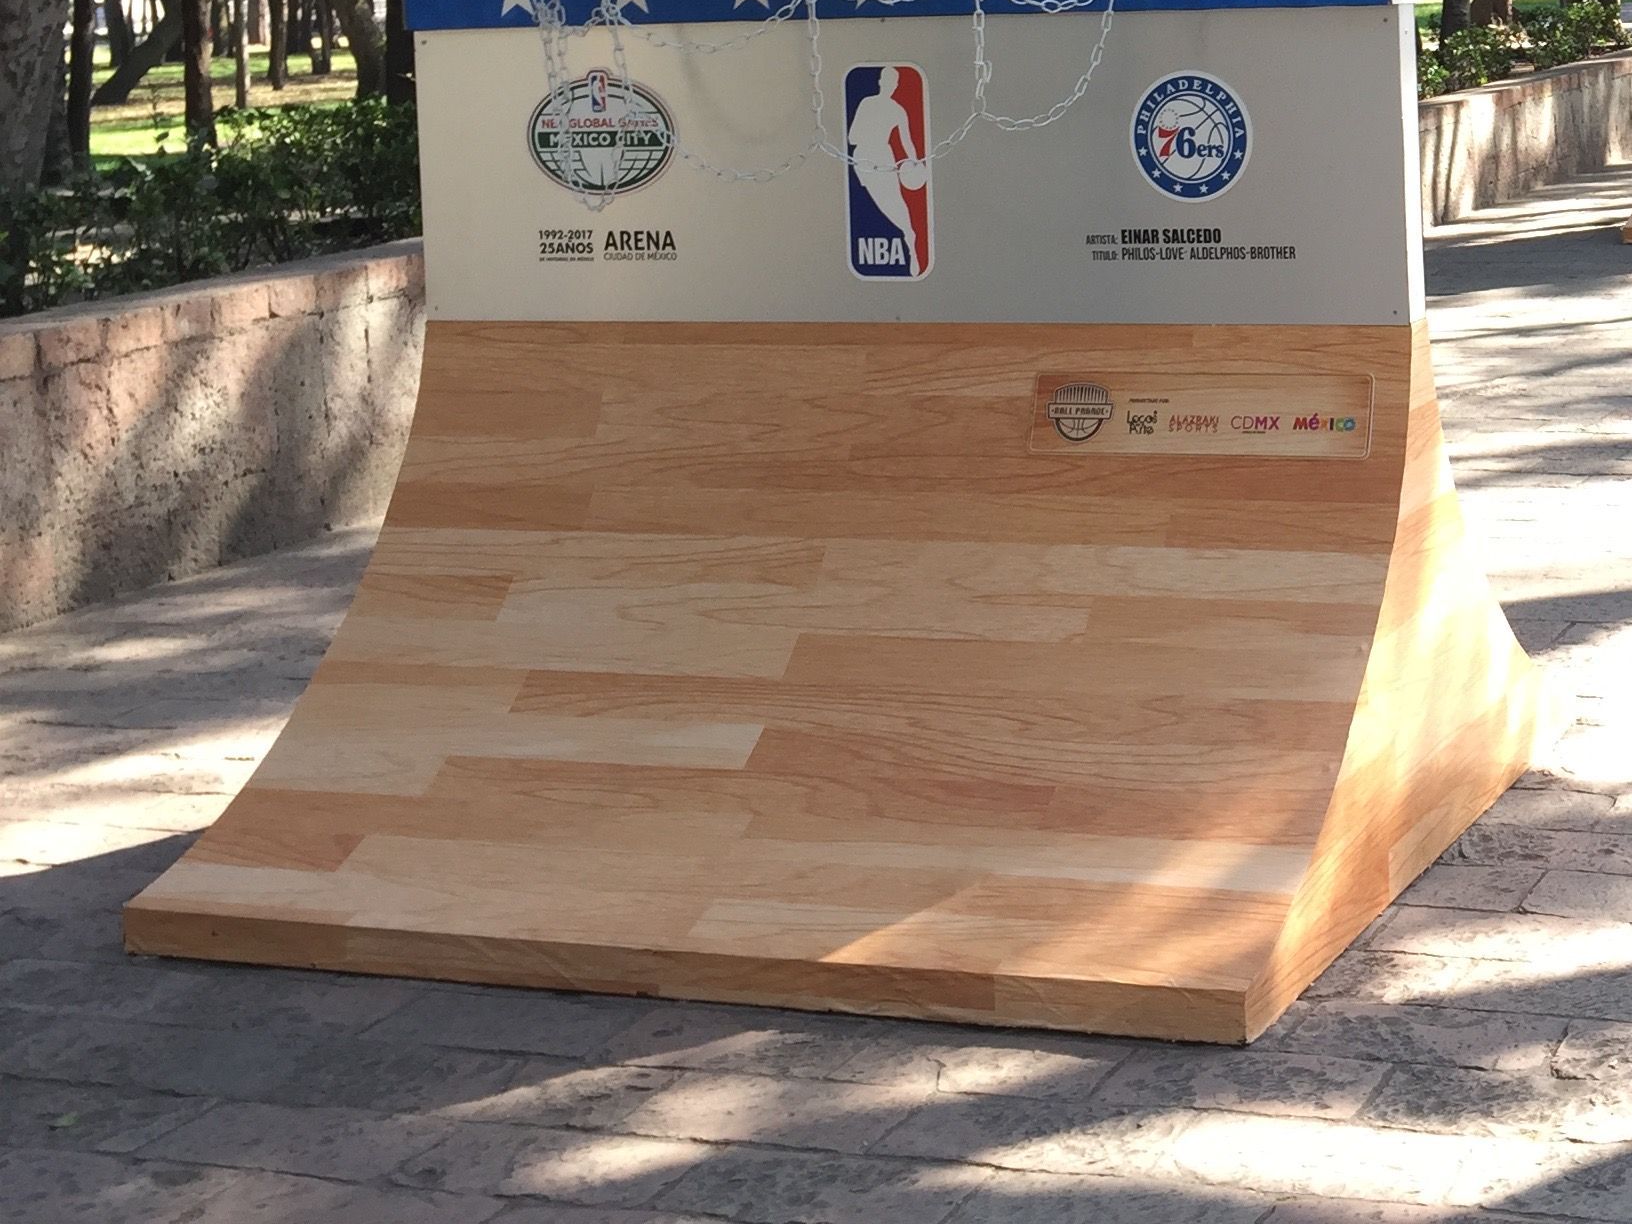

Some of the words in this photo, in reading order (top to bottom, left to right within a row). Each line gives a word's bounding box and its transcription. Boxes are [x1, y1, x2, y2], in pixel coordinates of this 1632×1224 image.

[1136, 78, 1246, 138] PHILADELPHIA
[569, 118, 615, 129] GLOBAL
[1158, 126, 1225, 159] 76ers
[538, 229, 593, 240] 1992-2017
[604, 230, 677, 251] ARENA
[1121, 229, 1160, 244] EINAR
[1162, 228, 1222, 244] SALCEDO
[603, 252, 634, 261] CIUDAD
[635, 252, 646, 261] DE
[858, 237, 906, 265] NBA
[1190, 246, 1297, 260] ALDELPHOS-BROTHER
[1230, 415, 1281, 430] CDMX
